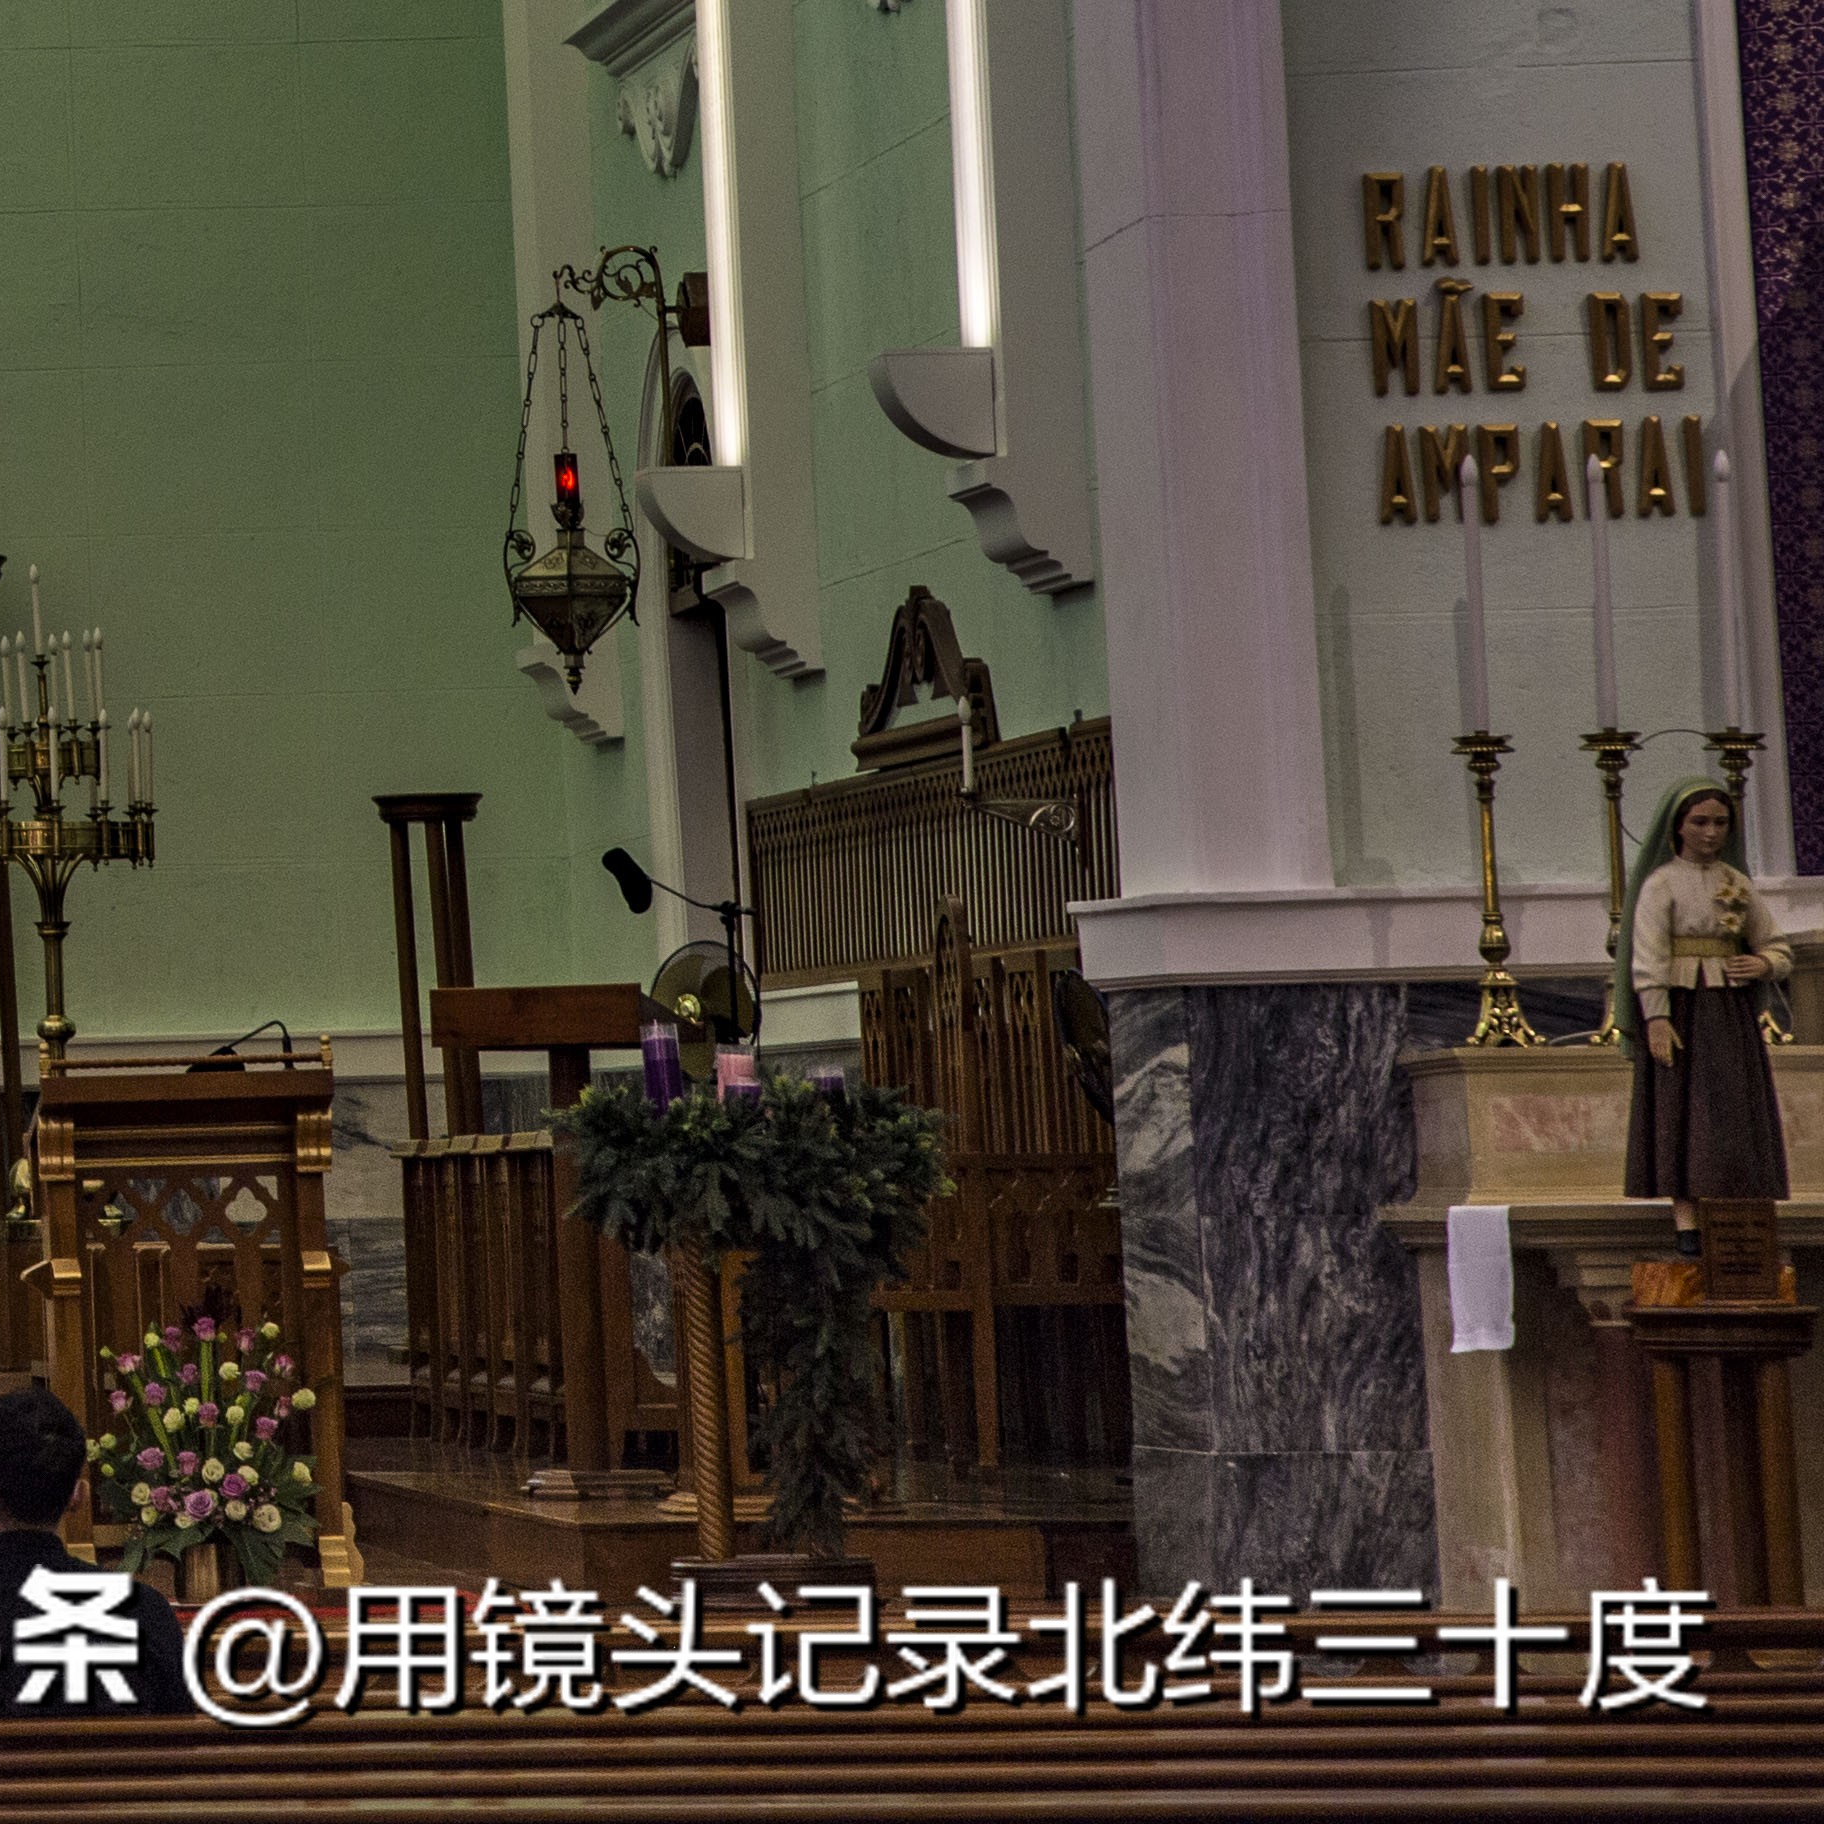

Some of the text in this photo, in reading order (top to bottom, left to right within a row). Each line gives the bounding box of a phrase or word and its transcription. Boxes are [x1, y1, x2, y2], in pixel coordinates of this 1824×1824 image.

[1361, 161, 1640, 271] RAINHA
[1369, 276, 1685, 397] MÃE DE
[1379, 414, 1707, 526] AMPARAI
